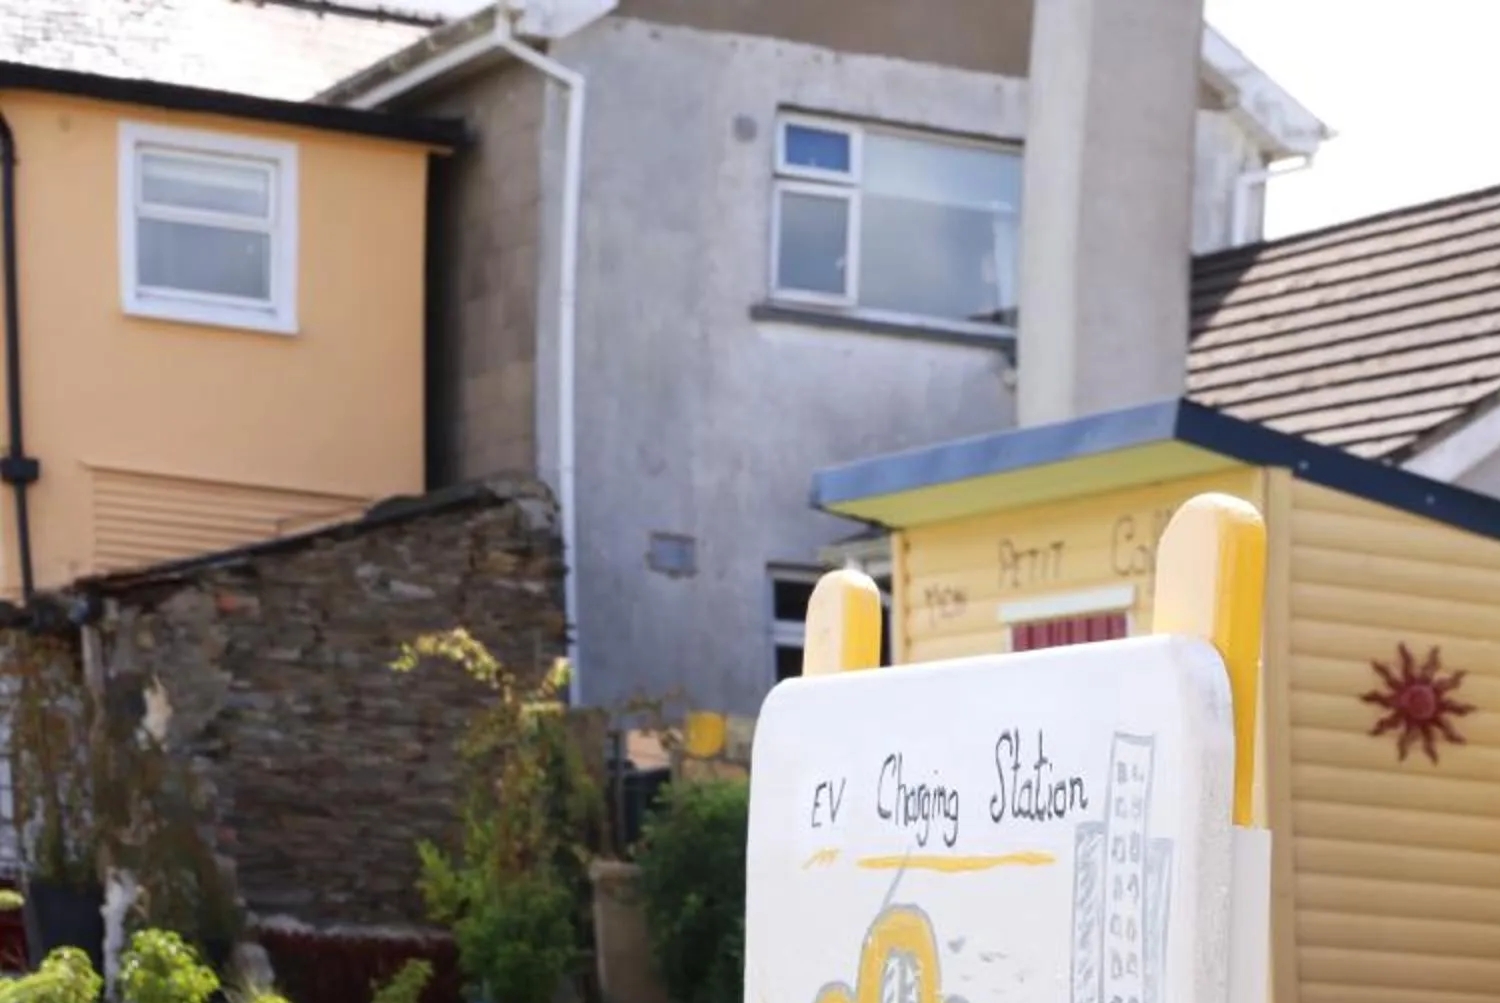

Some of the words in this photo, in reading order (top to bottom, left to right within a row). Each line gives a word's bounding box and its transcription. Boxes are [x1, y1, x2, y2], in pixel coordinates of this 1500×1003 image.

[811, 778, 847, 829] EV
[876, 751, 960, 848] Charging
[989, 728, 1089, 825] Station
